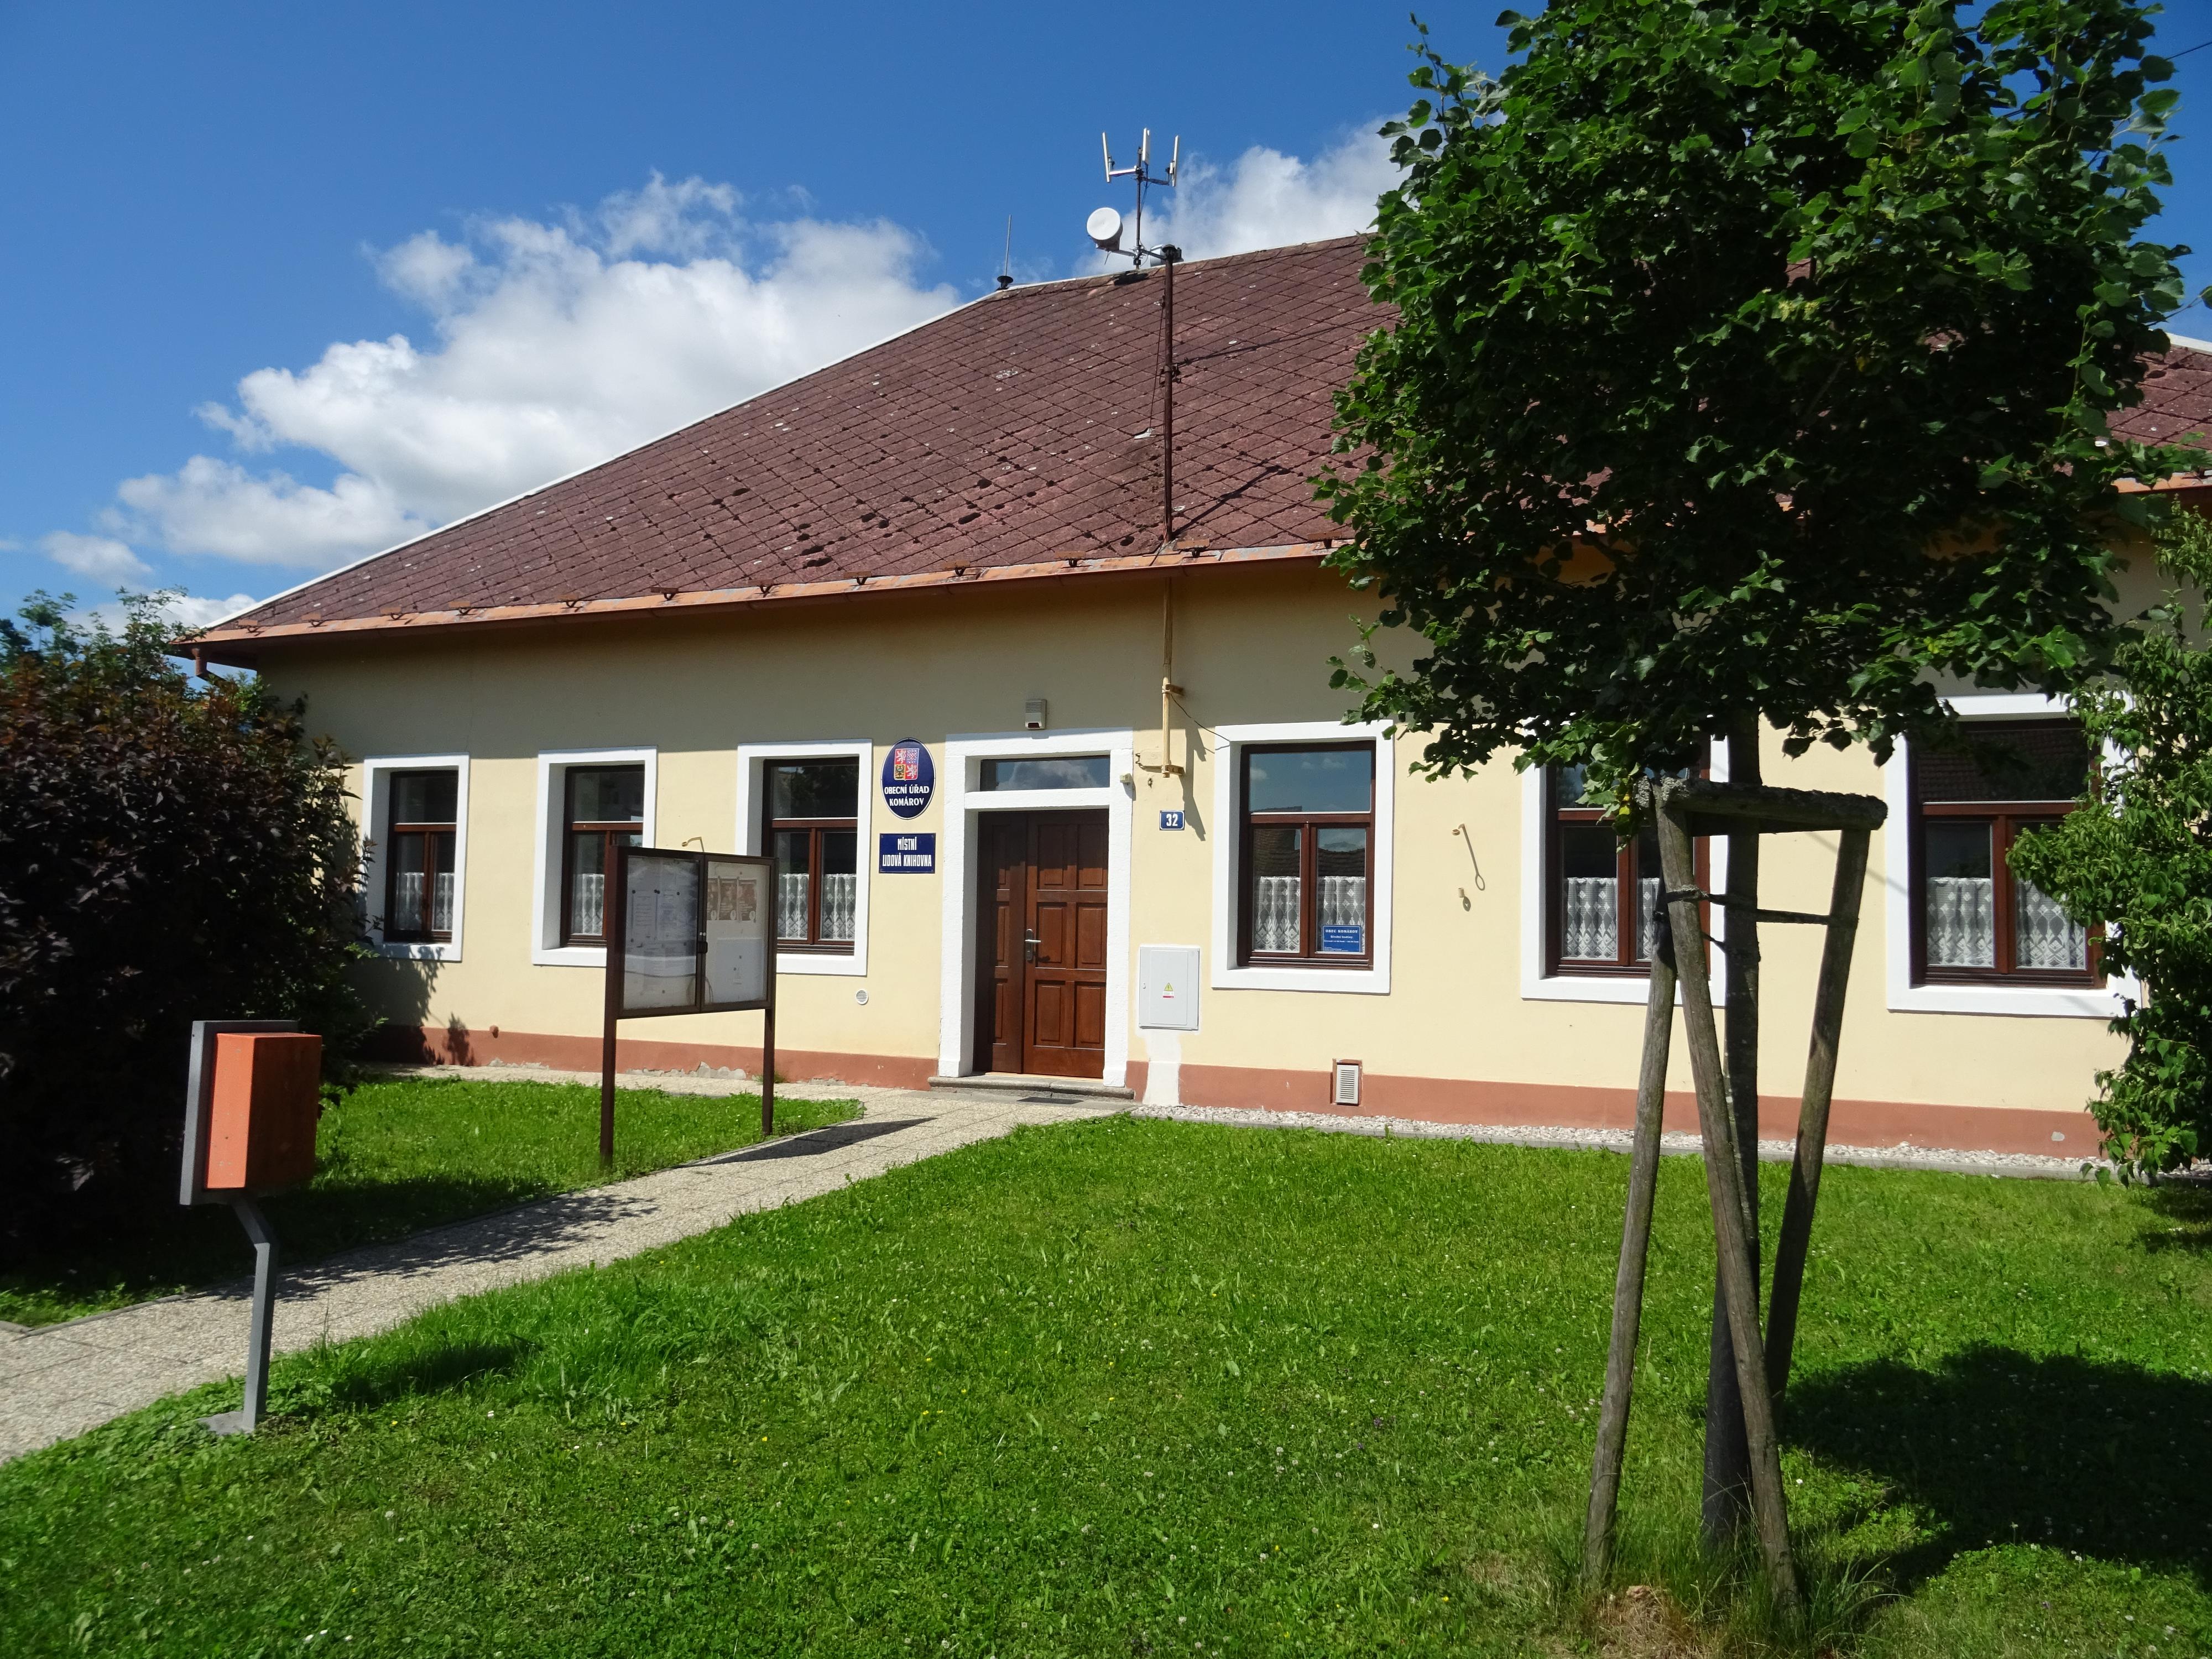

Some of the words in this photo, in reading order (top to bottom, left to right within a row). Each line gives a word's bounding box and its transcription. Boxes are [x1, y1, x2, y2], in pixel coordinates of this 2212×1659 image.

[884, 784, 907, 794] OBECNÍ
[909, 784, 930, 794] ÚŘAD
[889, 796, 924, 806] KOMÁROV
[1166, 813, 1178, 826] 32
[898, 836, 917, 850] MÍSTNÍ
[882, 852, 901, 867] LIDOVÁ
[903, 854, 932, 867] KNIHOVNA
